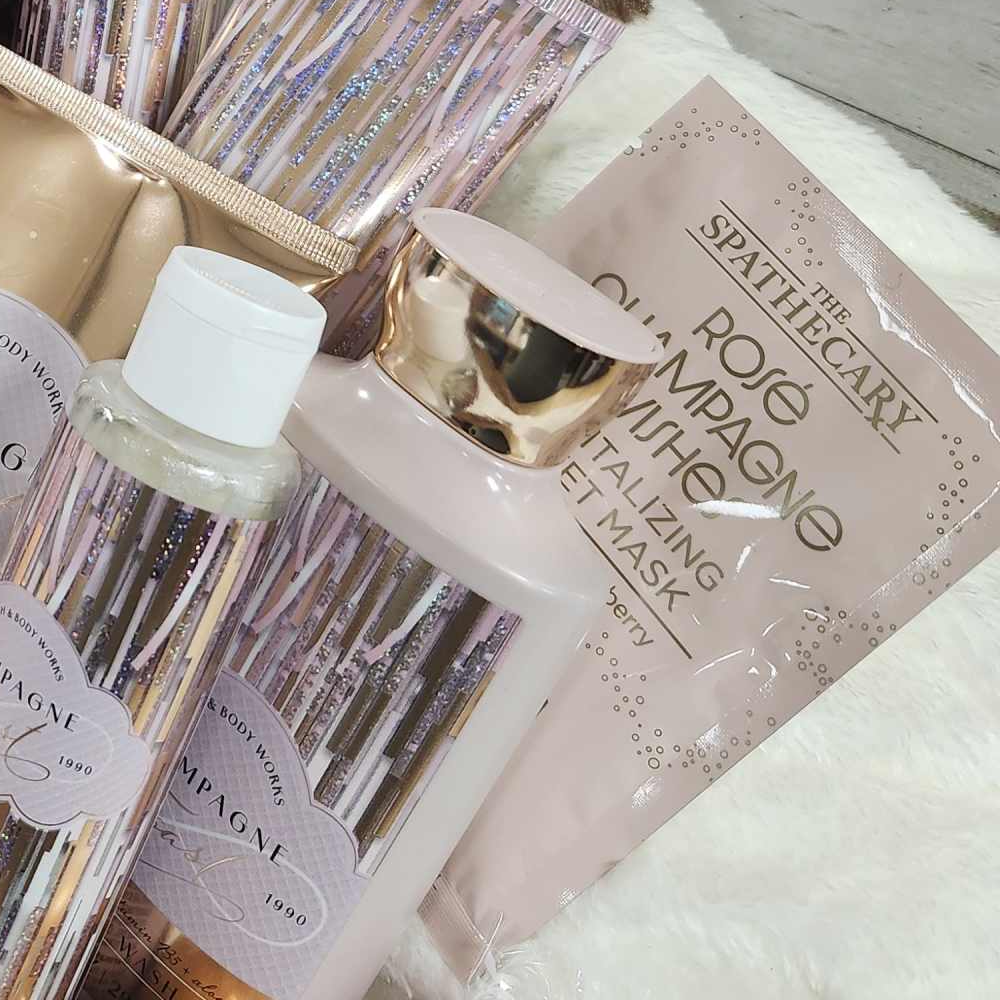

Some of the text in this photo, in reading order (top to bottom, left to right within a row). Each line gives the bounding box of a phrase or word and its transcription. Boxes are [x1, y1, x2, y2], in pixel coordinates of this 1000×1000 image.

[699, 213, 923, 433] SPATHECARY
[810, 281, 852, 326] THE
[580, 430, 725, 592] ITALIZING
[596, 507, 691, 613] MASK
[13, 614, 39, 638] BODY
[38, 636, 65, 683] WORKS
[57, 754, 94, 777] 1990
[219, 704, 257, 743] BODY
[255, 743, 286, 808] WORKS
[180, 754, 289, 868] MPAGNE
[264, 892, 308, 928] 1990
